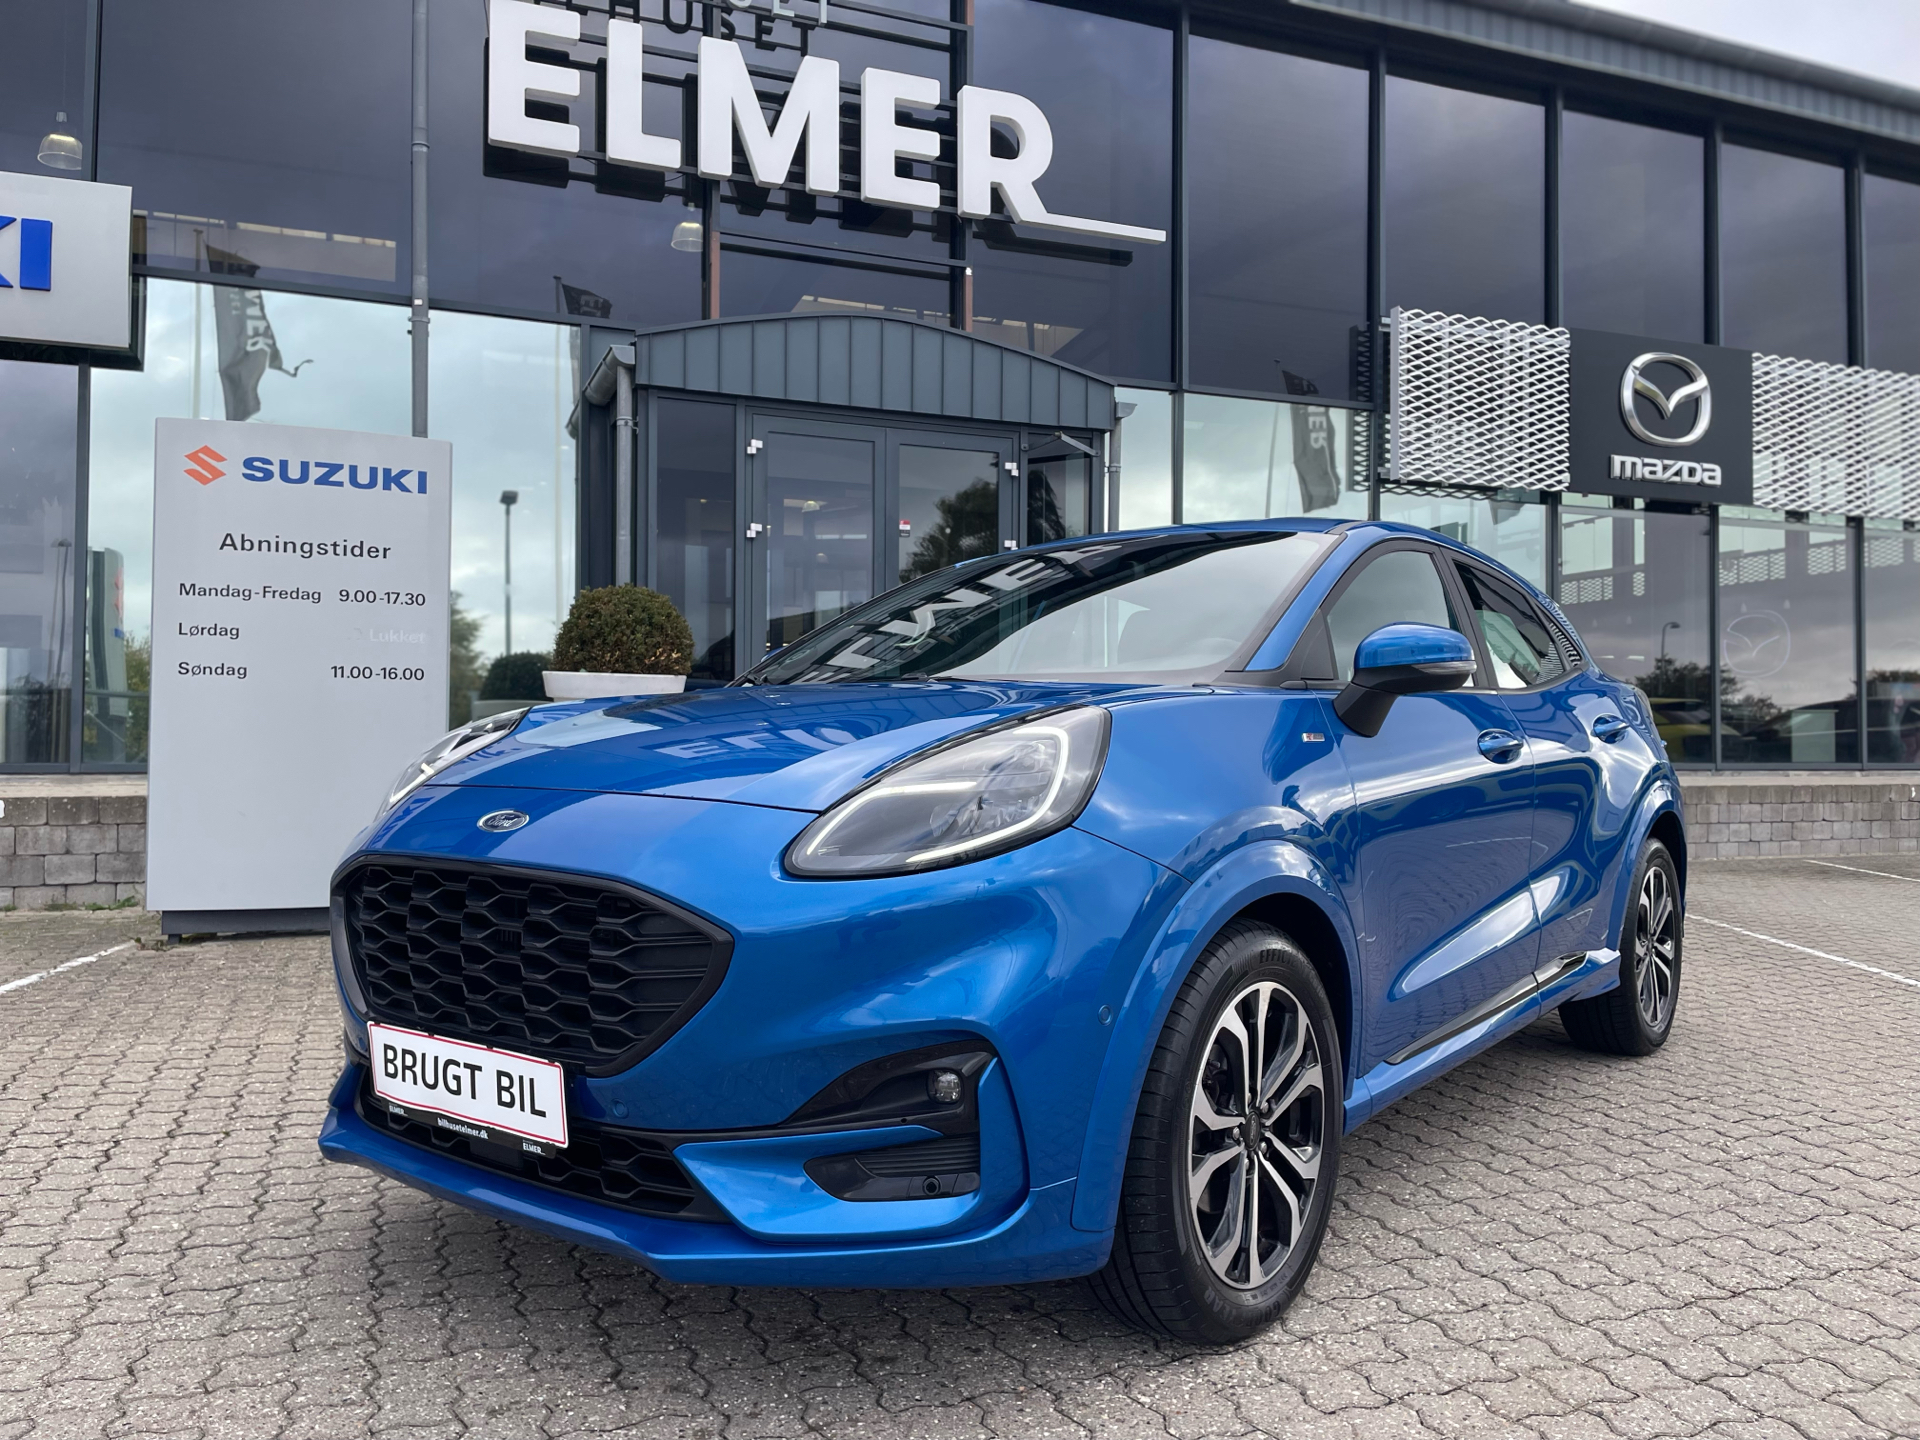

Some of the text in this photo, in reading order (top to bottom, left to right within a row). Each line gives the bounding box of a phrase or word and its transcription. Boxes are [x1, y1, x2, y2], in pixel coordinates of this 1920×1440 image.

[488, 0, 1166, 243] ELMER
[242, 457, 427, 494] SUZUKI
[219, 533, 391, 559] Abningstider
[178, 623, 425, 644] Lørdag Lukket
[178, 662, 425, 681] Søndag 11.00-16.00
[383, 1043, 547, 1118] BRUGT BIL
[437, 1117, 489, 1139] bilhusetelmer.dk
[523, 1143, 545, 1155] ELMER
